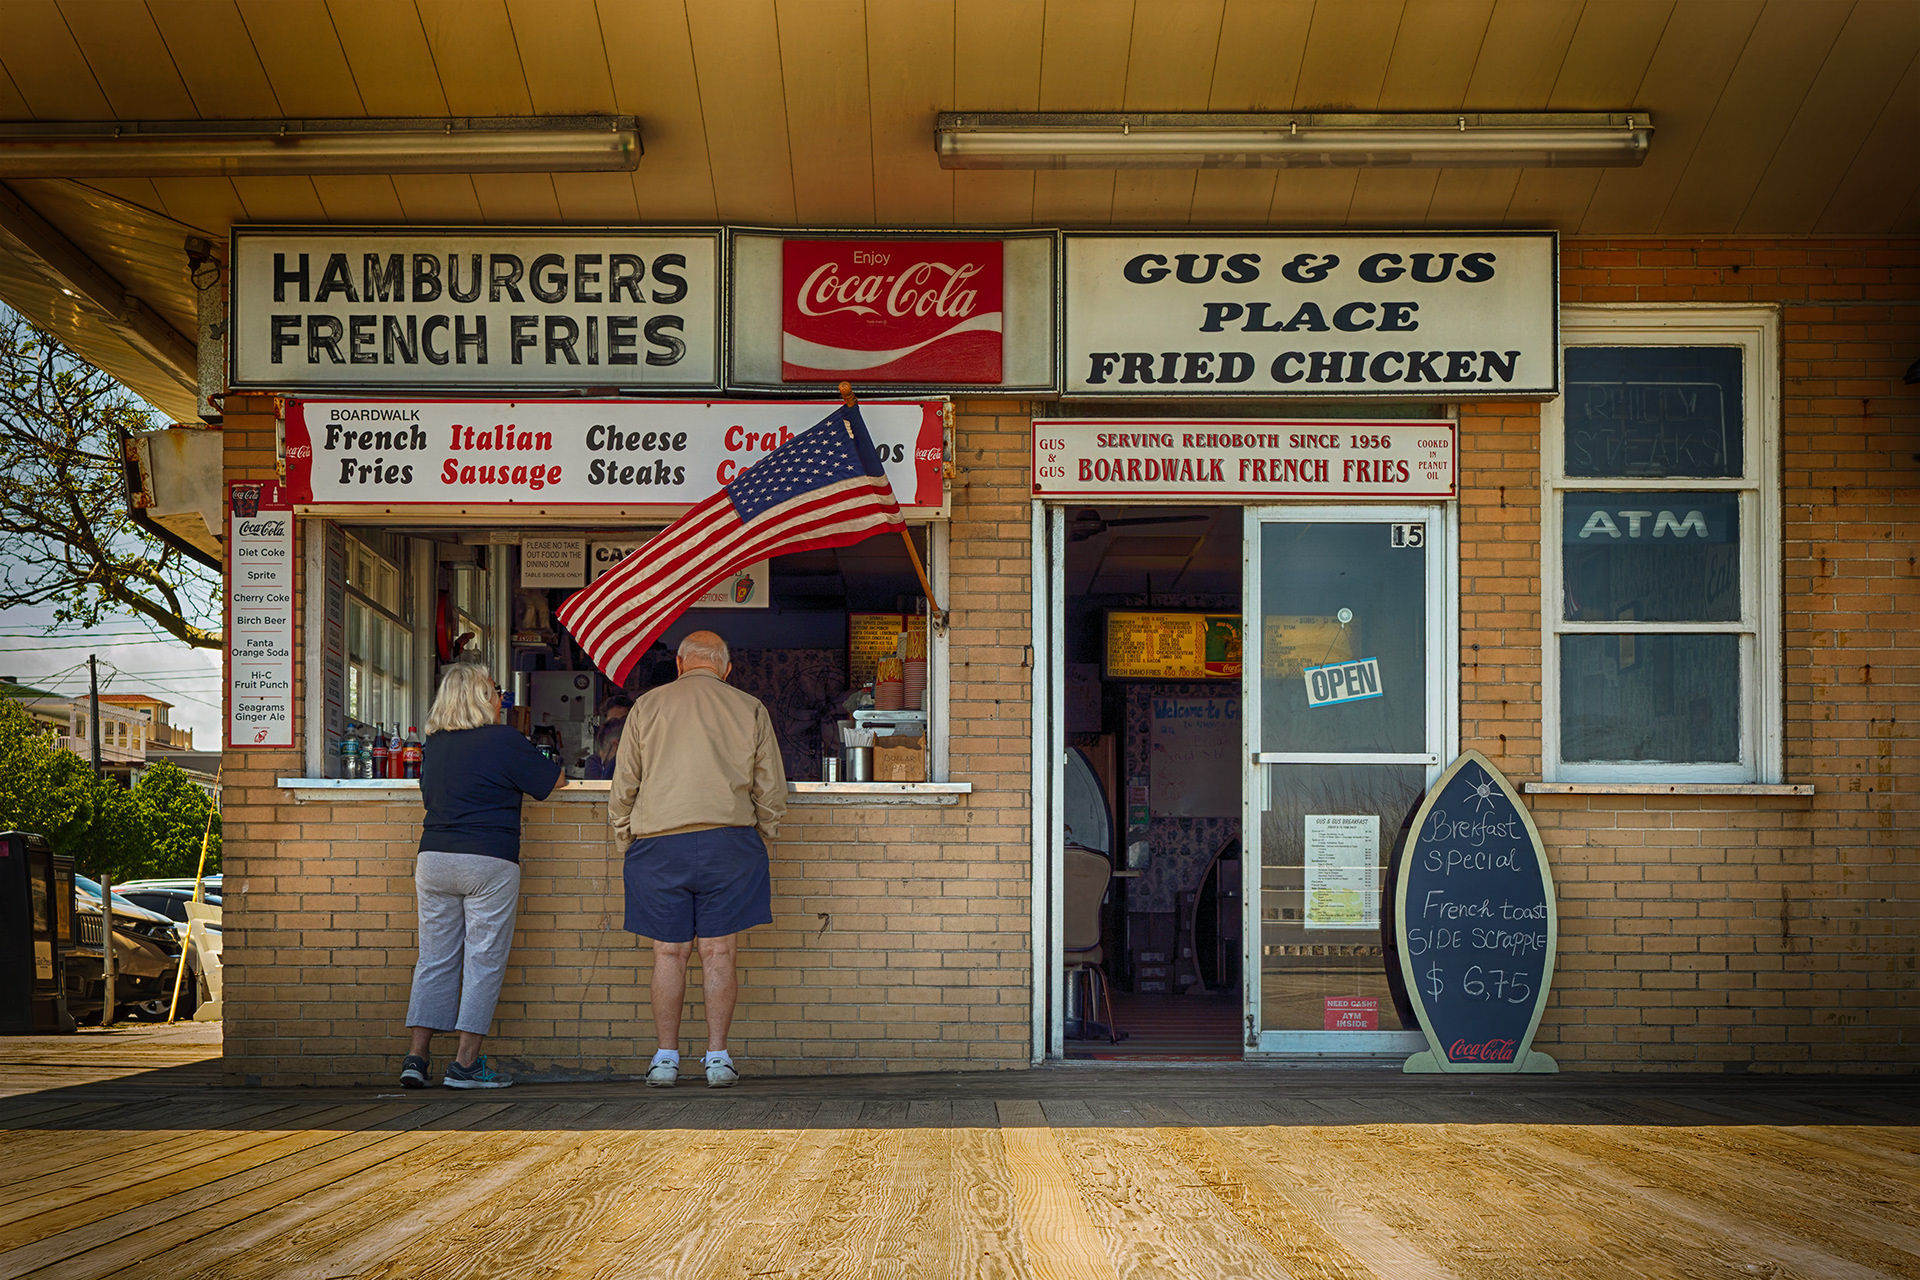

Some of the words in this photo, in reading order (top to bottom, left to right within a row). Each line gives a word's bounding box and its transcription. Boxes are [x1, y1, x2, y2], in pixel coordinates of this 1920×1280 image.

[853, 251, 890, 266] Enjoy
[1123, 253, 1261, 284] GUS
[1281, 254, 1339, 283] &
[1358, 252, 1496, 283] GUS
[273, 252, 688, 304] HAMBURGERS
[797, 261, 985, 319] Coca-Cola
[1200, 302, 1420, 332] PLACE
[270, 314, 489, 365] FRENCH
[510, 314, 686, 366] FRIES
[1085, 351, 1255, 385] FRIED
[1270, 351, 1521, 384] CHICKEN
[331, 410, 420, 421] BOARDWALK
[324, 424, 427, 451] French
[449, 423, 553, 451] Italian
[585, 424, 688, 452] Cheese
[1096, 433, 1174, 449] SERVING
[1182, 433, 1280, 449] REHOBOTH
[1289, 434, 1339, 449] SINCE
[1350, 434, 1392, 449] 1956
[1039, 438, 1065, 451] GUS
[1417, 439, 1449, 449] COOKED
[1048, 453, 1057, 463] &
[1429, 450, 1438, 458] IN
[339, 458, 414, 485] Fries
[587, 458, 686, 486] Steaks
[1039, 466, 1065, 478] GUS
[1077, 457, 1225, 483] BOARDWALK
[1238, 458, 1330, 483] FRENCH
[1342, 458, 1410, 483] FRIES
[1417, 461, 1448, 470] PEANUT
[440, 458, 562, 492] Sausage
[1426, 471, 1440, 480] OIL
[239, 520, 284, 537] Coca-Cola
[1578, 510, 1709, 539] ATM
[1394, 525, 1422, 546] 15
[526, 541, 551, 550] PLEASE
[552, 541, 563, 550] NO
[563, 541, 580, 550] TAKE
[239, 548, 259, 557] Diet
[262, 548, 285, 557] Coke
[526, 551, 541, 559] OUT
[541, 551, 560, 559] FOOD
[561, 551, 568, 559] IN
[569, 551, 582, 559] THE
[526, 560, 549, 568] DINING
[549, 560, 570, 568] ROOM
[247, 571, 276, 581] Sprite
[233, 593, 264, 604] Cherry
[266, 593, 290, 602] Coke
[237, 616, 263, 625] Birch
[264, 616, 287, 625] Beer
[246, 639, 273, 648] Fanta
[232, 648, 264, 659] Orange
[266, 648, 289, 657] Soda
[251, 671, 272, 680] Hi-C
[1311, 662, 1378, 702] OPEN
[234, 680, 258, 689] Fruit
[259, 680, 289, 689] Punch
[238, 703, 285, 714] Seagrams
[1153, 699, 1203, 719] Welcome
[1205, 699, 1221, 719] to
[235, 712, 267, 722] Ginger
[269, 712, 285, 721] Ale
[1423, 890, 1494, 919] French
[1499, 898, 1547, 920] toast
[1342, 1012, 1362, 1020] ATM
[1336, 1020, 1368, 1028] INSIDE
[1449, 1037, 1517, 1061] Coca-Cola
